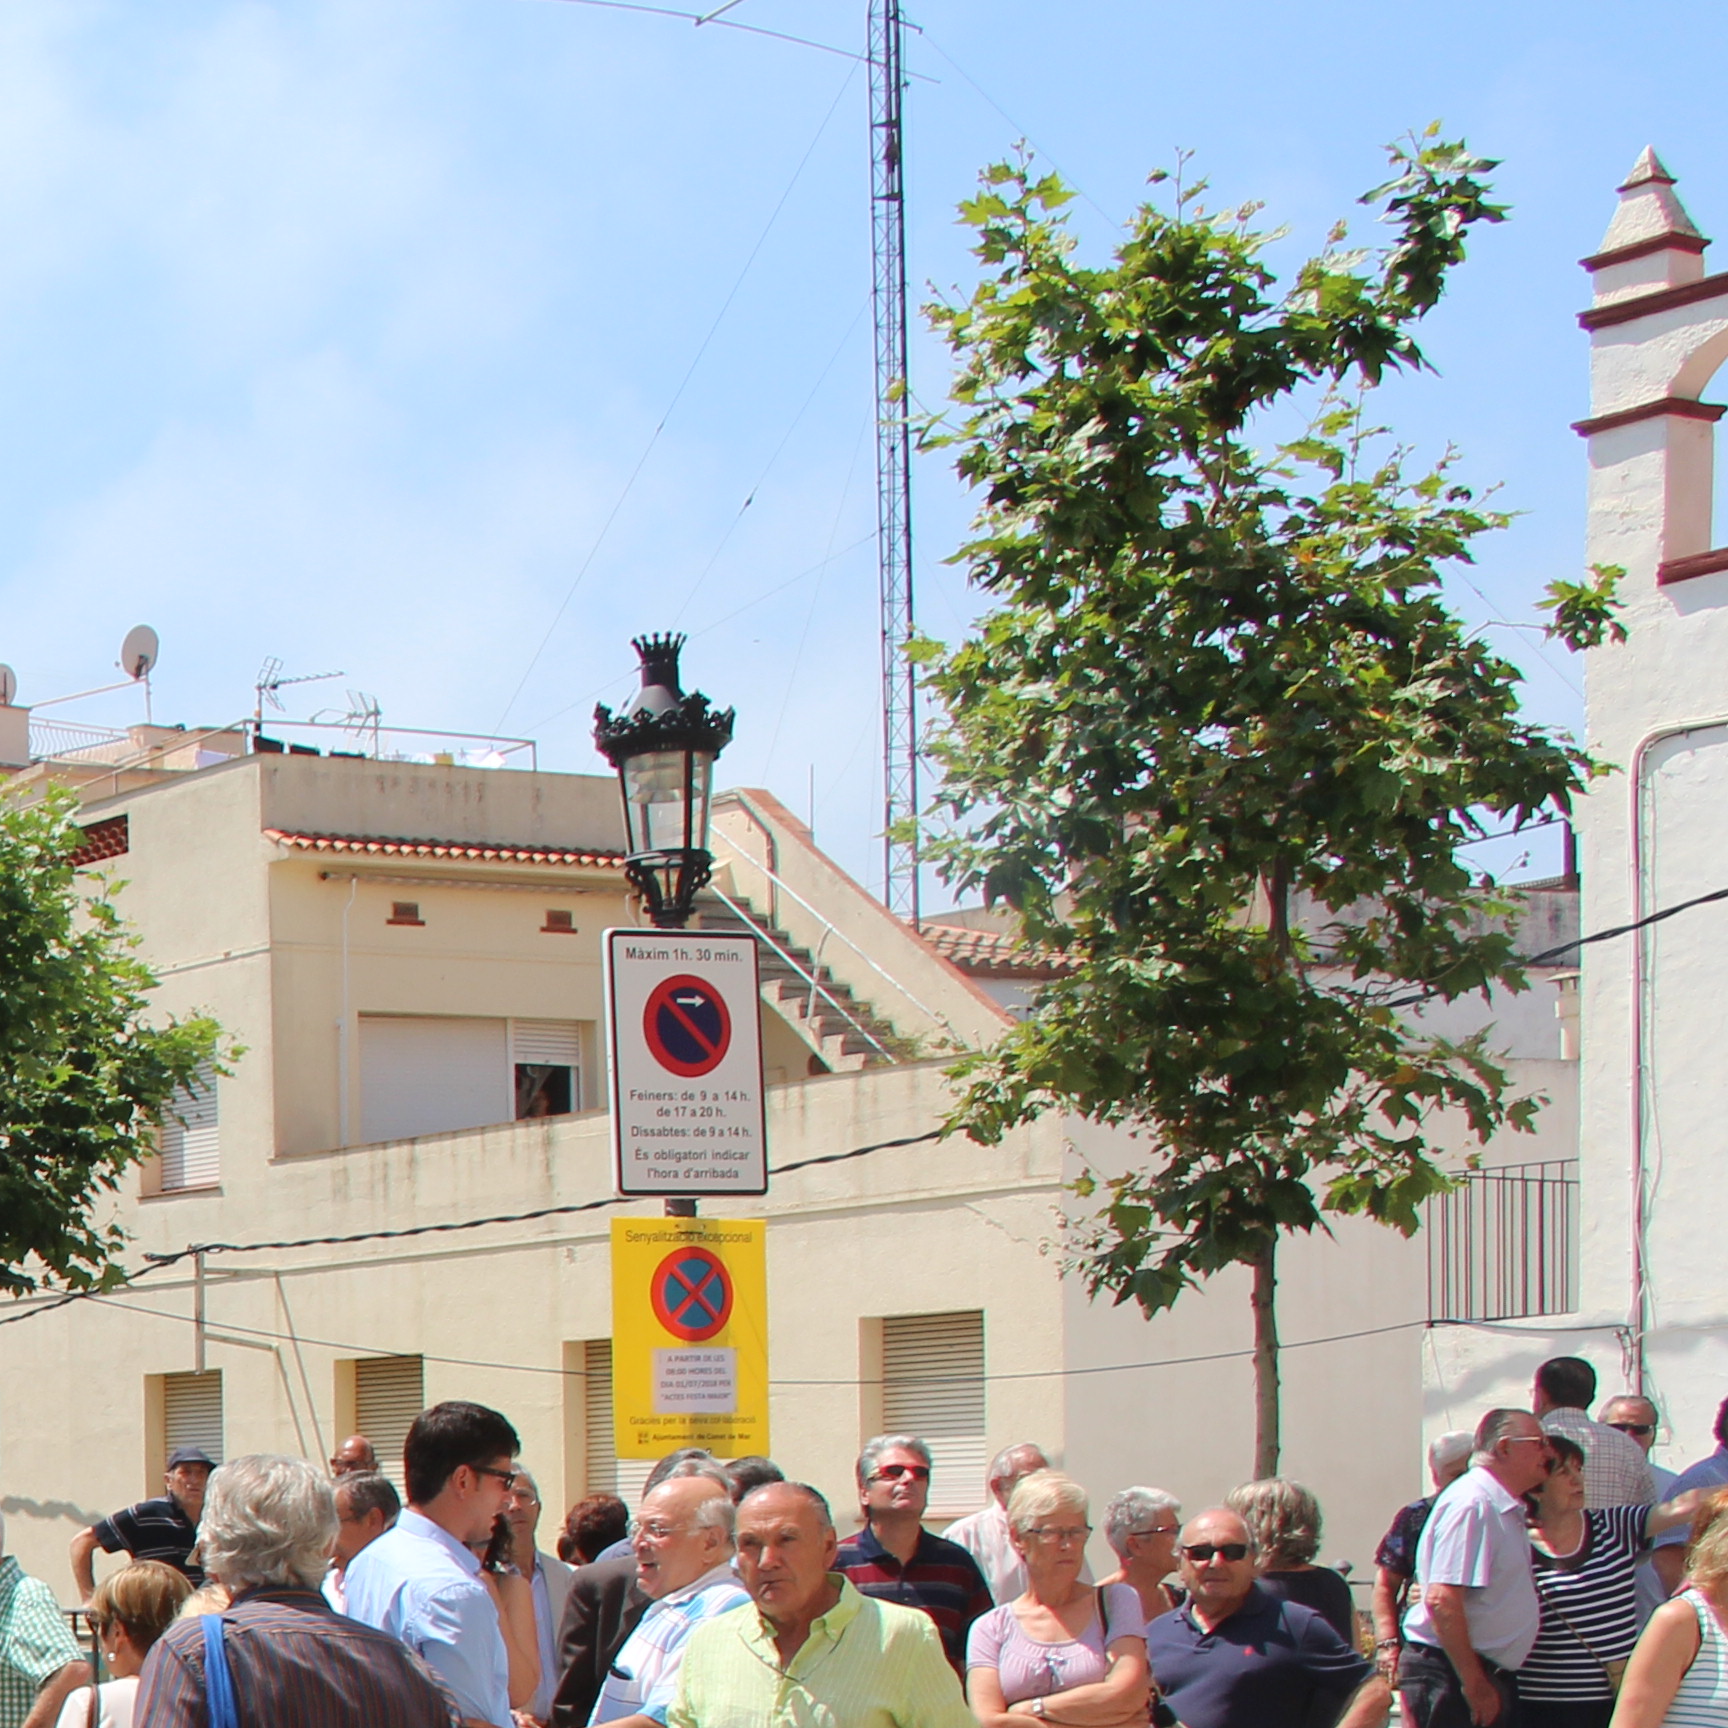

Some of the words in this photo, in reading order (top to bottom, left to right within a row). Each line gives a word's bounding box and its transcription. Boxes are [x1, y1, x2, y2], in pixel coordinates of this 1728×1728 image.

[626, 947, 669, 960] Màxim
[673, 948, 692, 960] 1h.
[696, 949, 711, 961] 30
[715, 949, 742, 962] min.
[630, 1090, 677, 1100] Feiners:
[681, 1090, 695, 1101] de
[700, 1091, 707, 1101] 9
[712, 1093, 718, 1101] a
[725, 1091, 737, 1101] 14
[740, 1091, 751, 1101] h.
[656, 1107, 670, 1117] de
[674, 1107, 687, 1117] 17
[690, 1109, 696, 1117] a
[699, 1107, 712, 1117] 20
[716, 1107, 726, 1117] h.
[631, 1126, 690, 1137] Dissabtes:
[693, 1127, 707, 1137] de
[709, 1127, 715, 1137] 9
[718, 1129, 724, 1137] a
[728, 1127, 739, 1137] 14
[742, 1127, 752, 1137] h.
[635, 1147, 649, 1161] És
[654, 1149, 707, 1163] obligatori
[712, 1149, 750, 1161] indicar
[647, 1168, 679, 1178] l'hora
[684, 1168, 739, 1179] d'arribada
